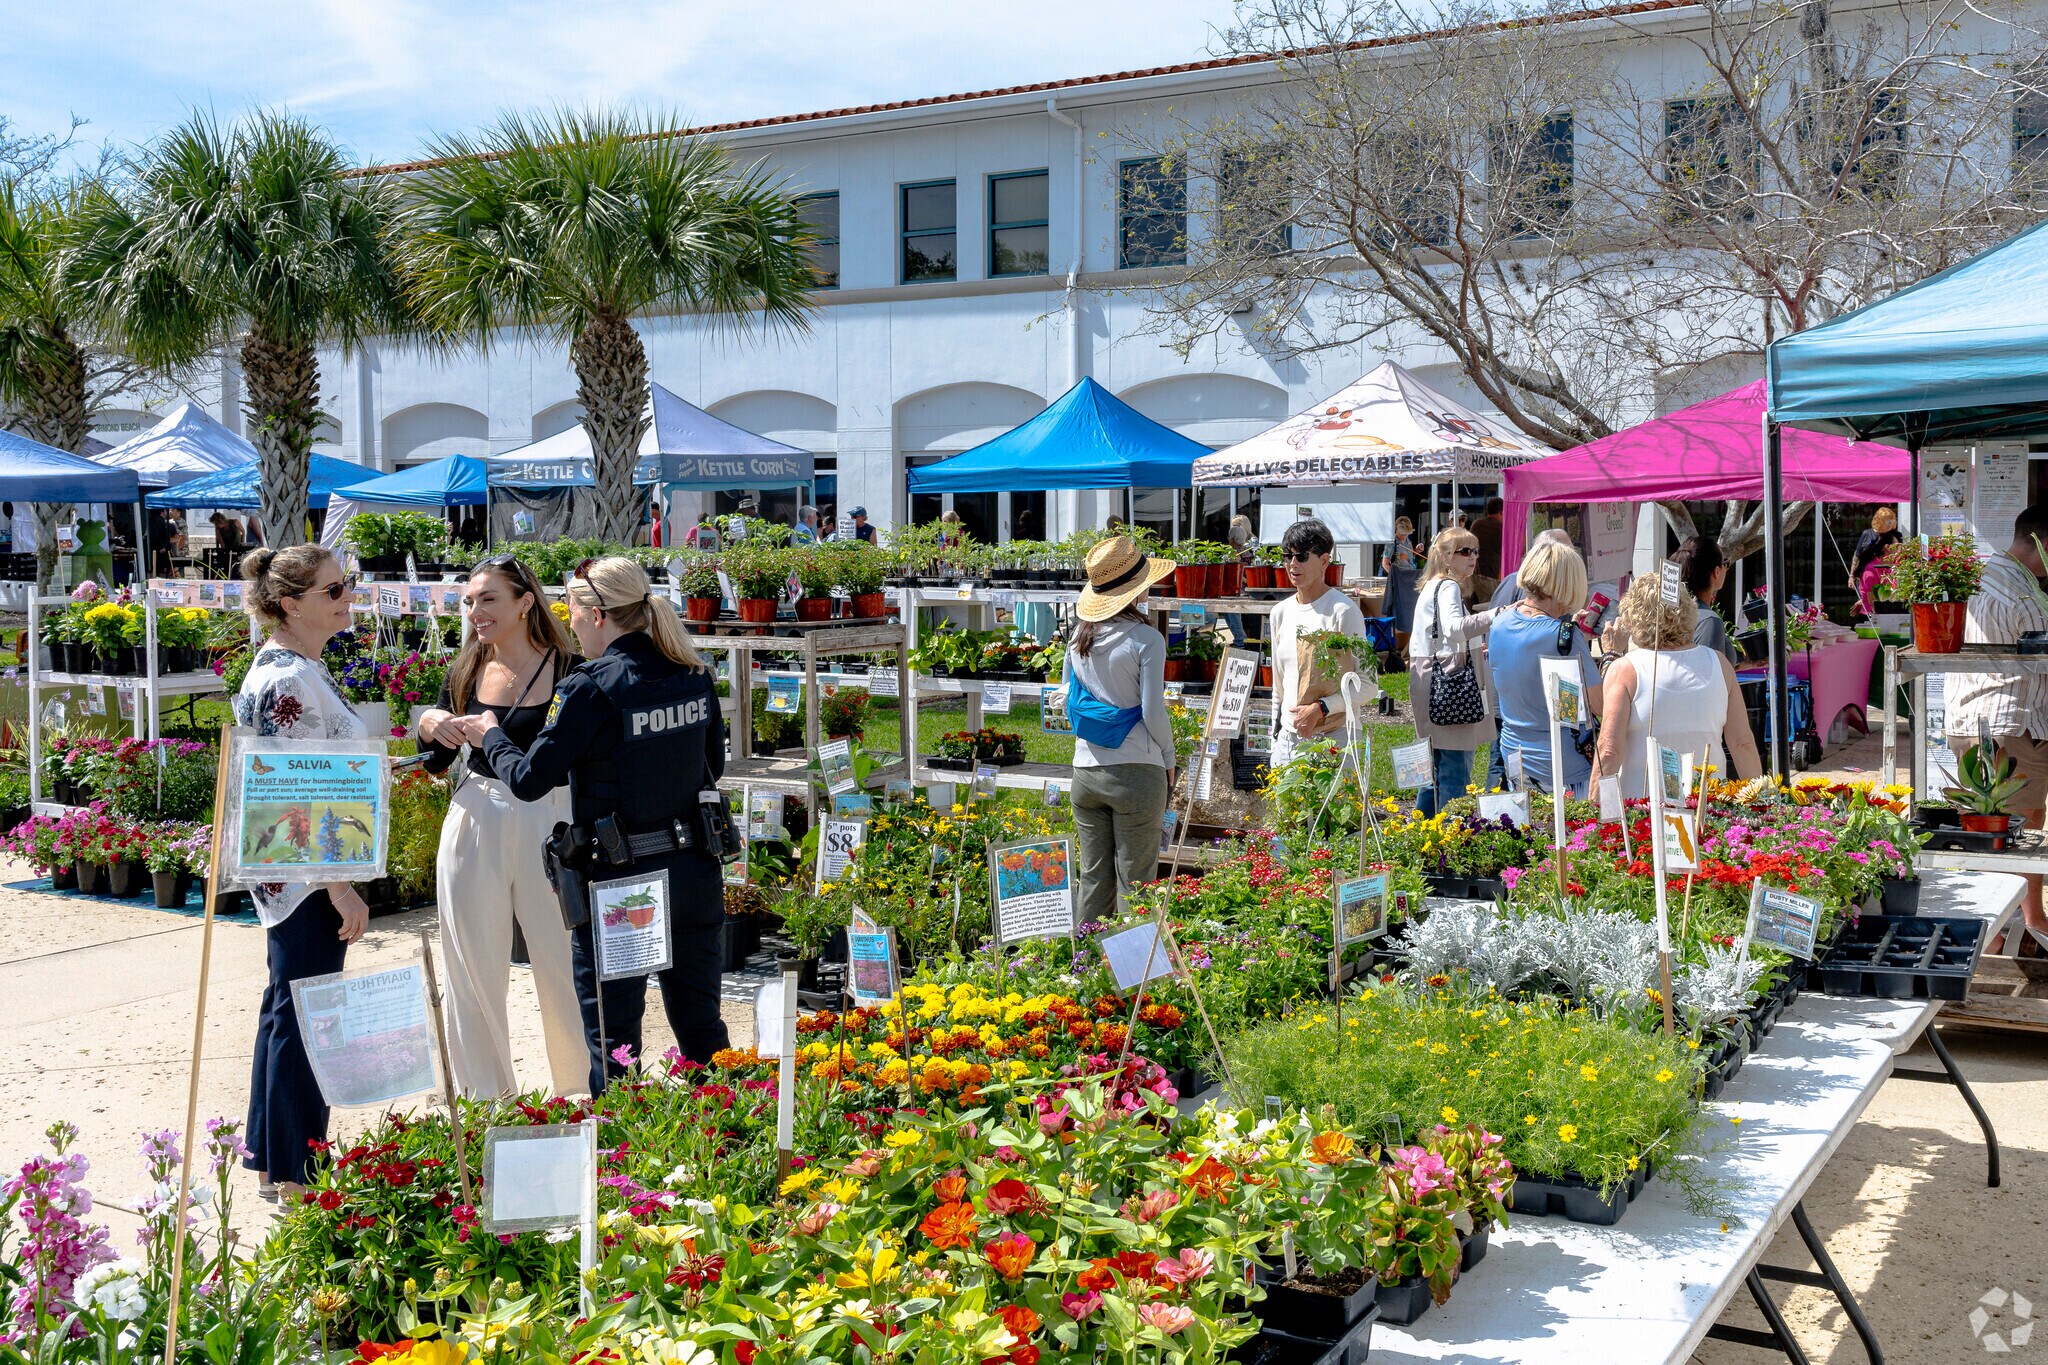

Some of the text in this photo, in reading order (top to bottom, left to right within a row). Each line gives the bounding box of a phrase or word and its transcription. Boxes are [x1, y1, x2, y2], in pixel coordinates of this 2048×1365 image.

[95, 423, 140, 432] ORMOND BEACH
[523, 463, 574, 480] KETTLE
[698, 458, 784, 476] KETTLE CORN
[1296, 454, 1424, 473] DELECTABLES
[382, 595, 398, 606] $15
[632, 698, 708, 736] POLICE
[288, 760, 332, 770] SALVIA
[828, 832, 852, 852] $8
[1770, 894, 1788, 902] DUSTY
[1789, 898, 1810, 909] MILLER
